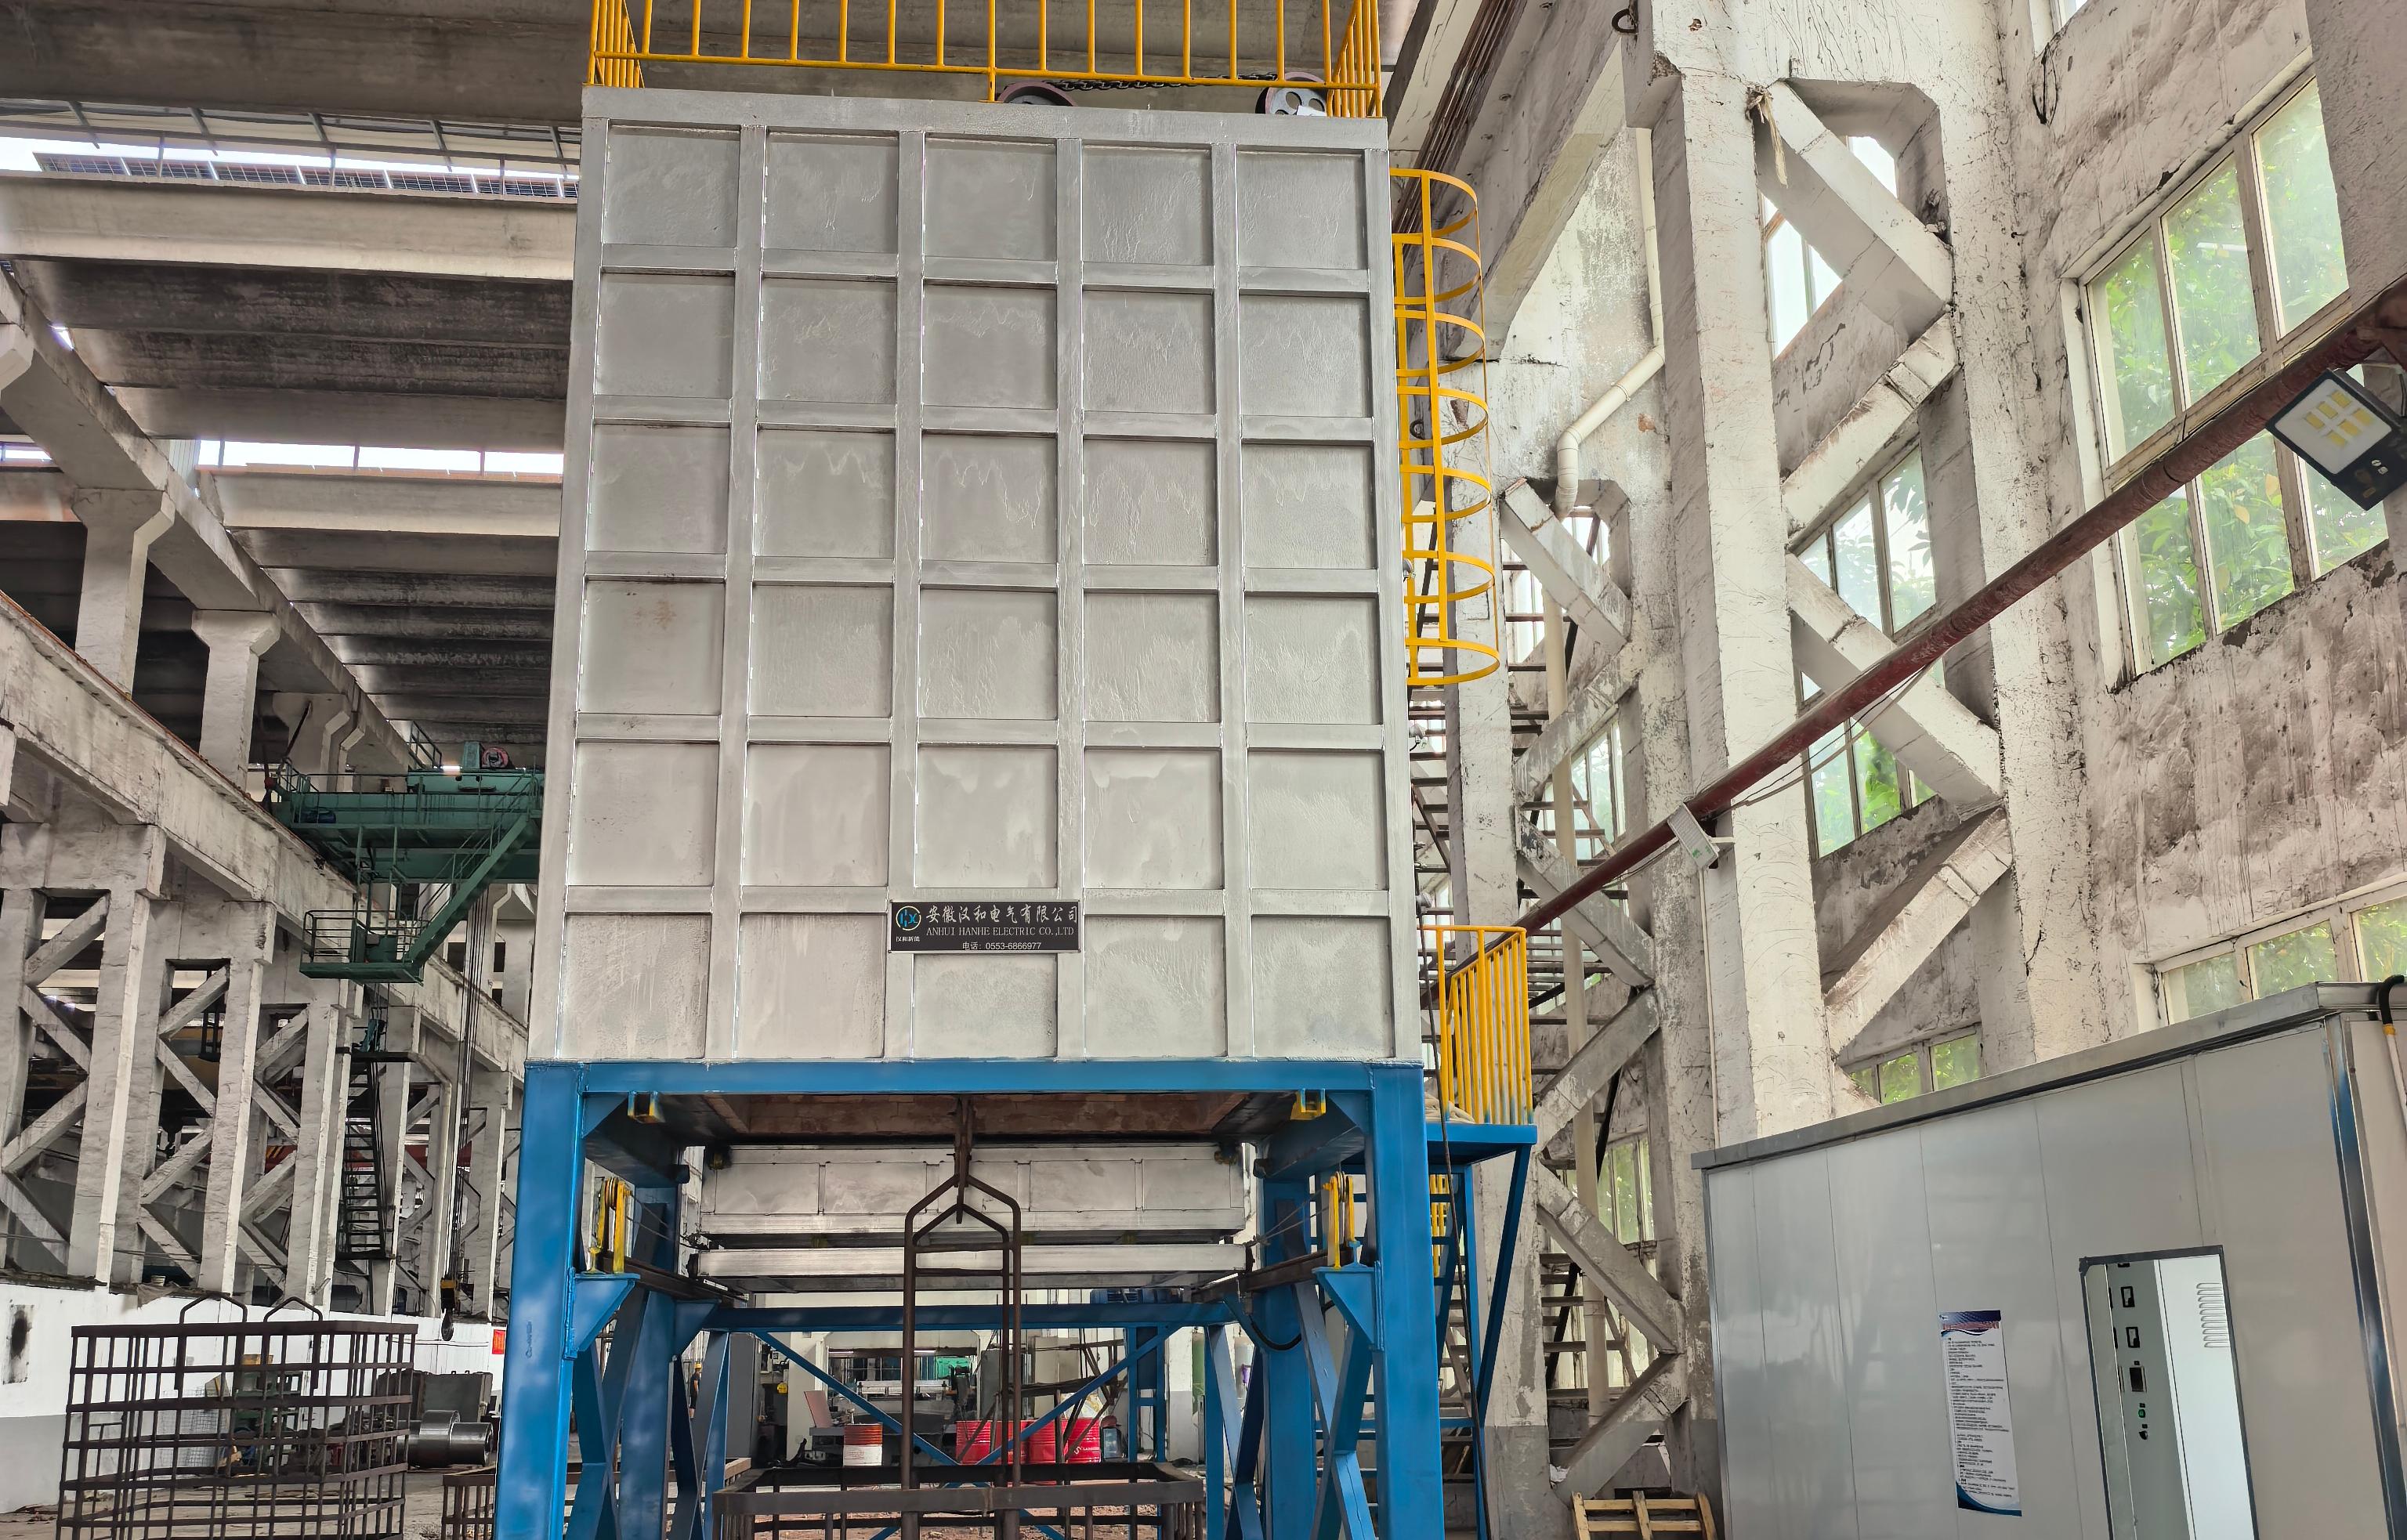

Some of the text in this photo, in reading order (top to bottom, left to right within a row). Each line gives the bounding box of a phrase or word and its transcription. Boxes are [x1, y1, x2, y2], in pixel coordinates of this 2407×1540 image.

[926, 905, 1077, 924] 安徽汉和电气有限公司
[926, 927, 956, 936] ANHUI
[959, 927, 990, 936] HANHE
[993, 927, 1036, 936] ELECTRIC
